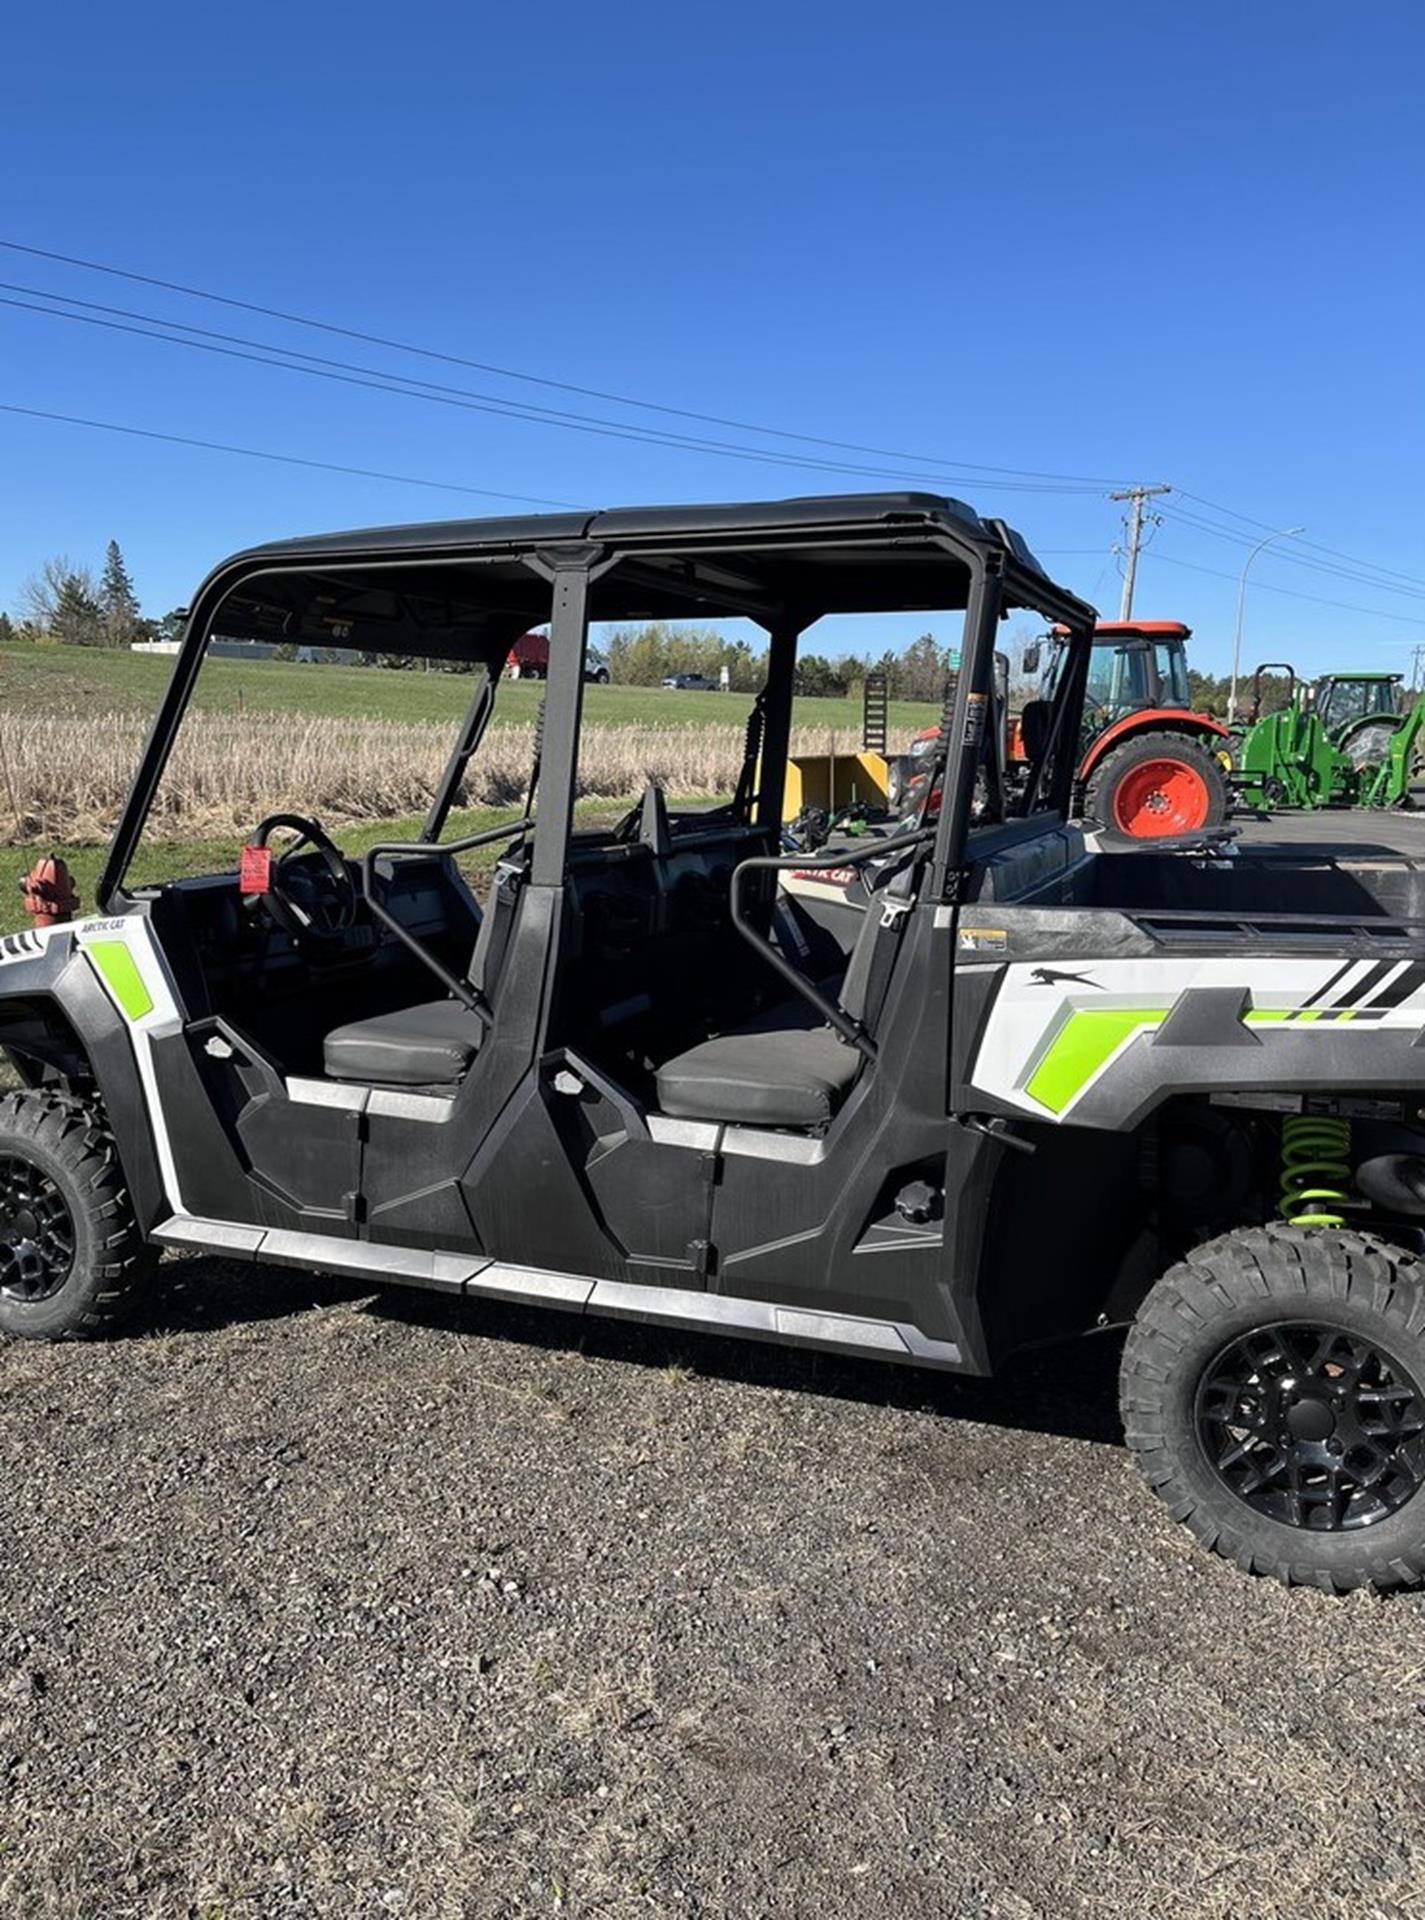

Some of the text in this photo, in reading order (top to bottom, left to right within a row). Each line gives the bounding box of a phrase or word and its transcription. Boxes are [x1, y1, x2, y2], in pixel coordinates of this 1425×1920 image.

[830, 868, 854, 883] CAT
[81, 918, 126, 933] ARCTIC CAT
